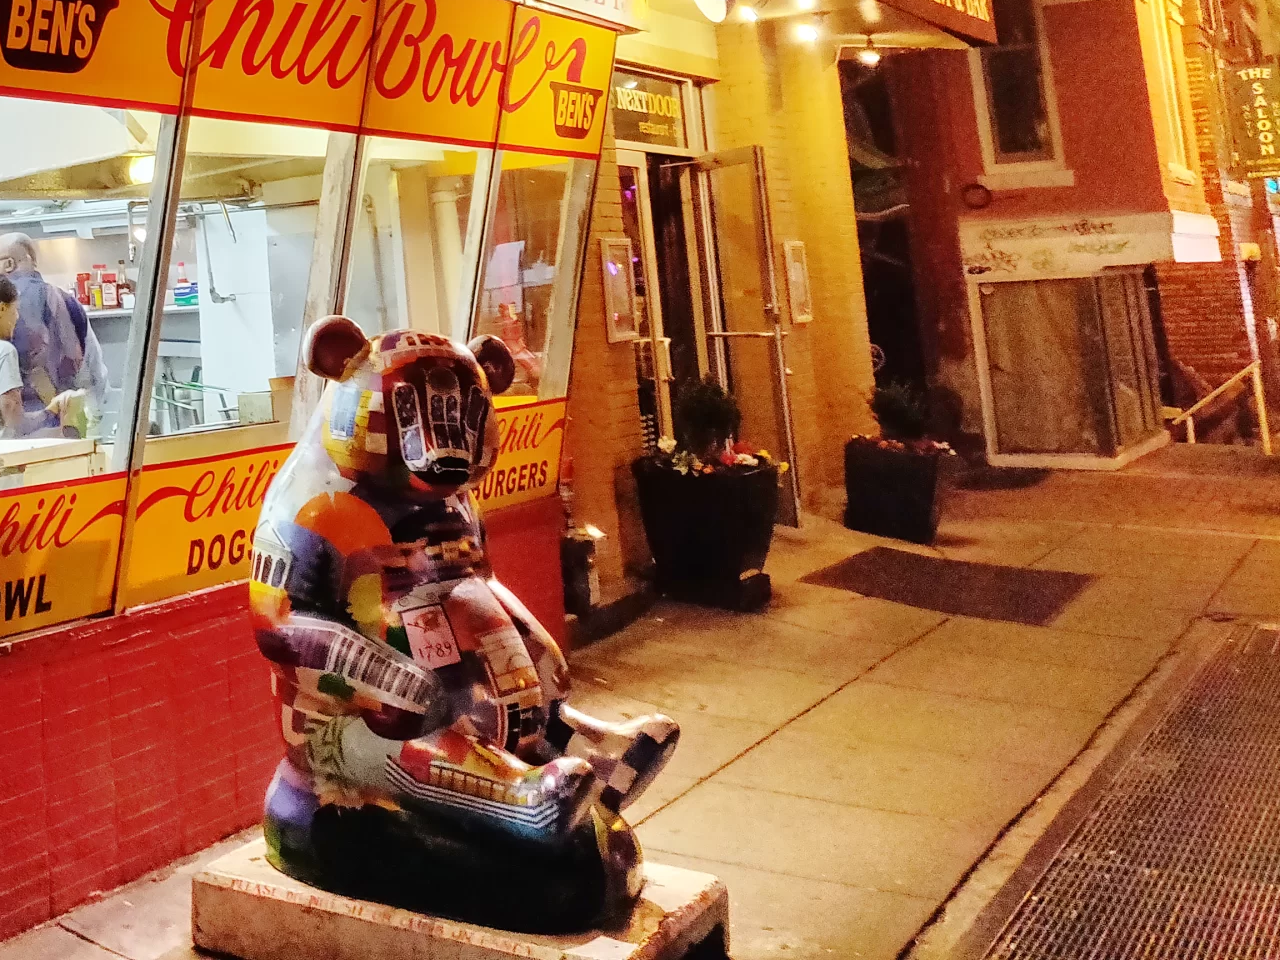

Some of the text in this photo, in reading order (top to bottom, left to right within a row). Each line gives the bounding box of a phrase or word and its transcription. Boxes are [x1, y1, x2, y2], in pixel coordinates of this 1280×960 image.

[1237, 67, 1271, 81] THE
[555, 90, 595, 131] BEN'S
[1252, 82, 1275, 157] SALOON
[183, 459, 279, 523] Chili
